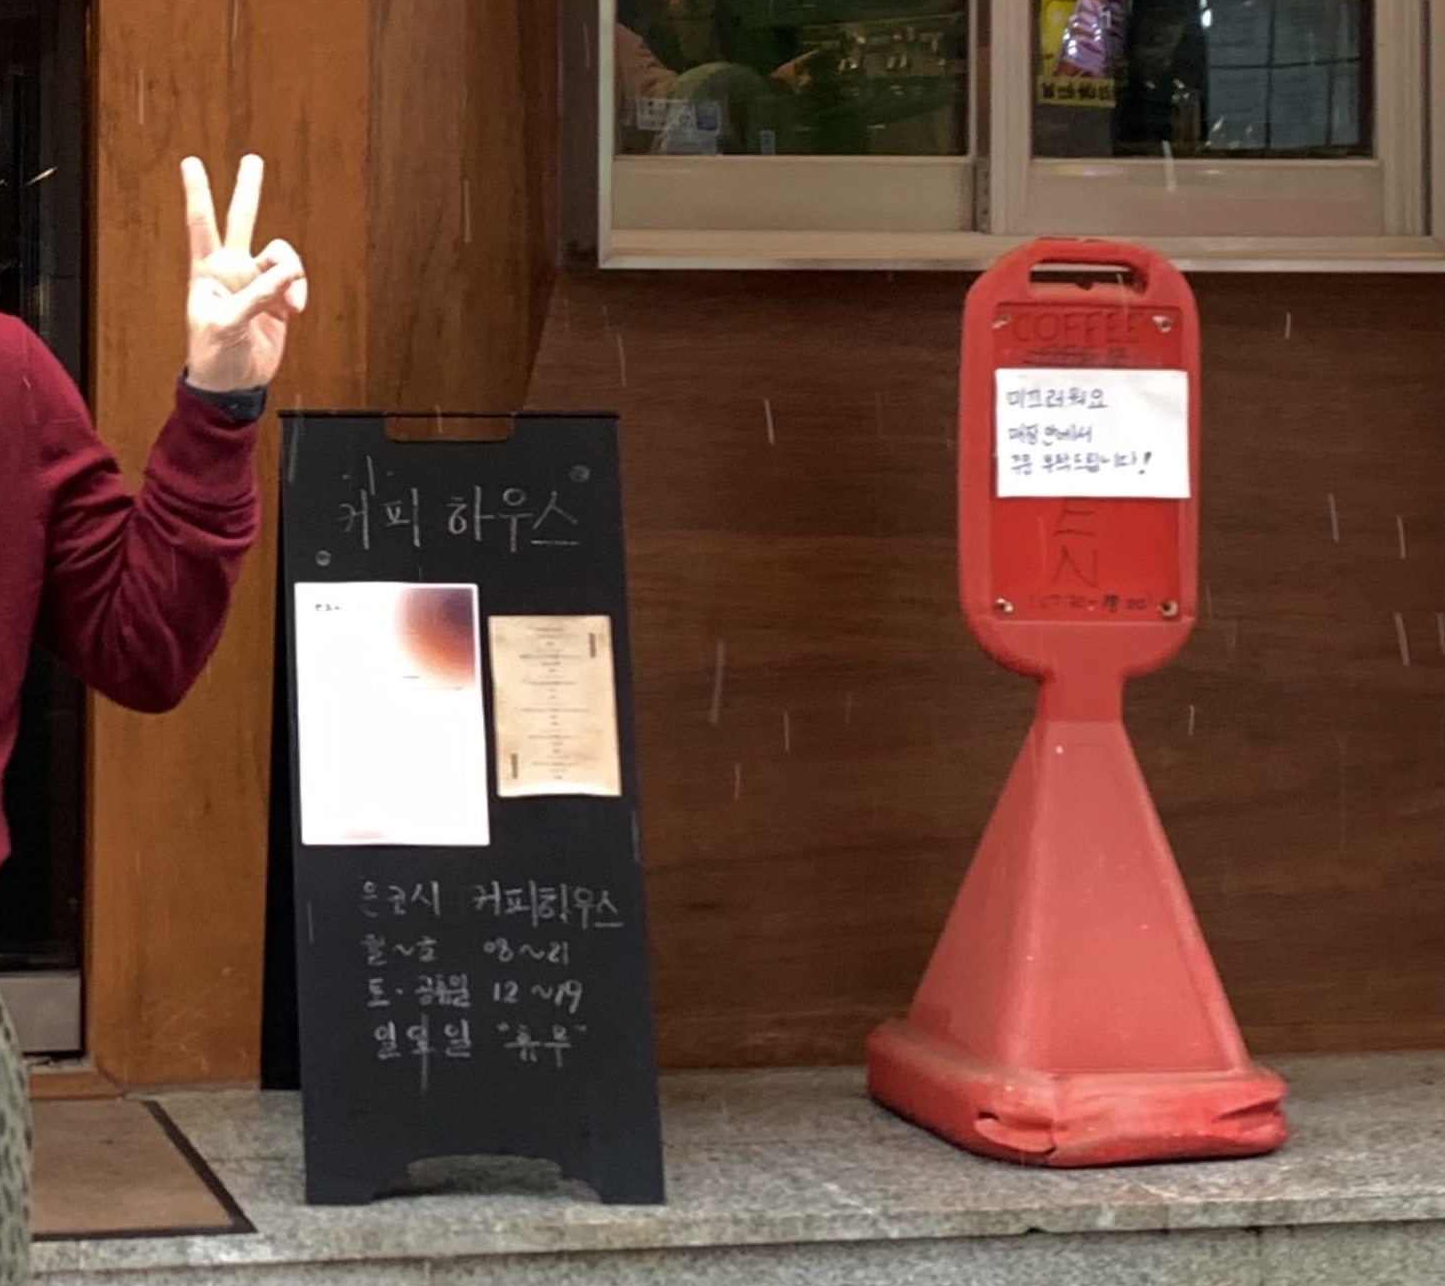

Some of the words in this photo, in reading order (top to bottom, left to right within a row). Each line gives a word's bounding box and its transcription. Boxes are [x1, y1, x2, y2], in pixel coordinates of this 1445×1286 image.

[336, 487, 422, 551] 커피
[444, 485, 581, 553] 하우스
[471, 879, 625, 930] 커피하우스
[373, 1018, 473, 1060] 일요일
